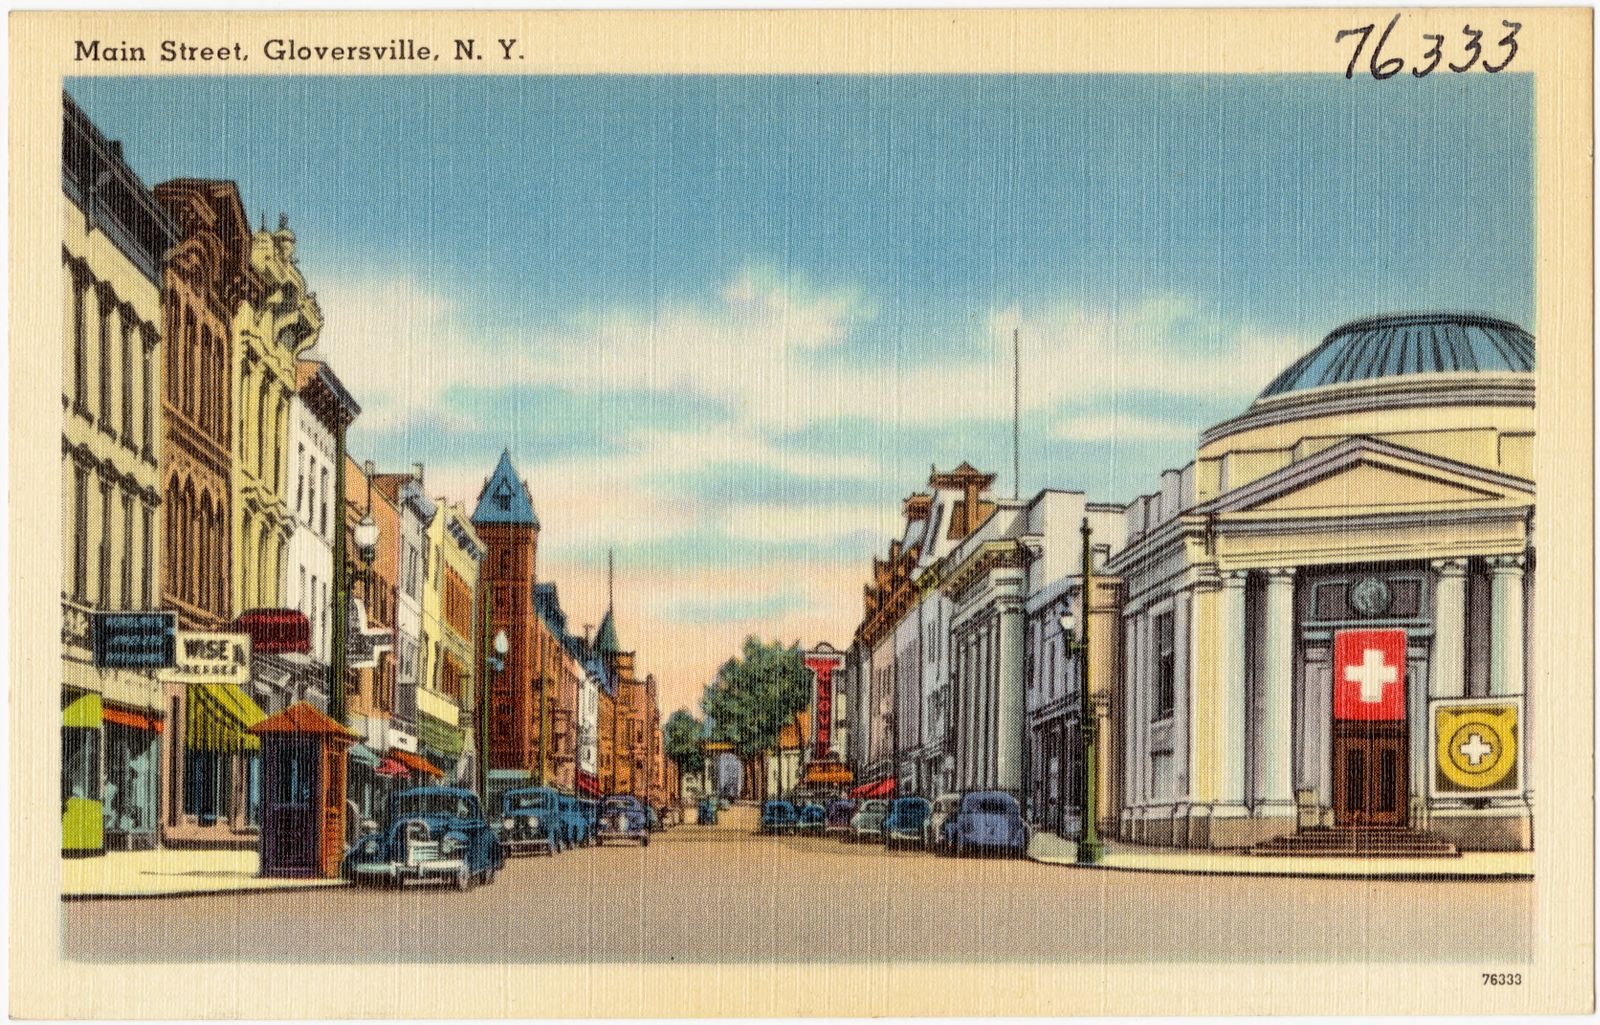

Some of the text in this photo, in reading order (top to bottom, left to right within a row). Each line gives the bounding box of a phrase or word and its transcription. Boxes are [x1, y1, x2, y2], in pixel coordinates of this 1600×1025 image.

[74, 38, 524, 63] Main Street, Gloversville, N. Y.
[1336, 13, 1523, 80] 76333
[183, 639, 229, 661] WISE
[1482, 973, 1522, 986] 76333
